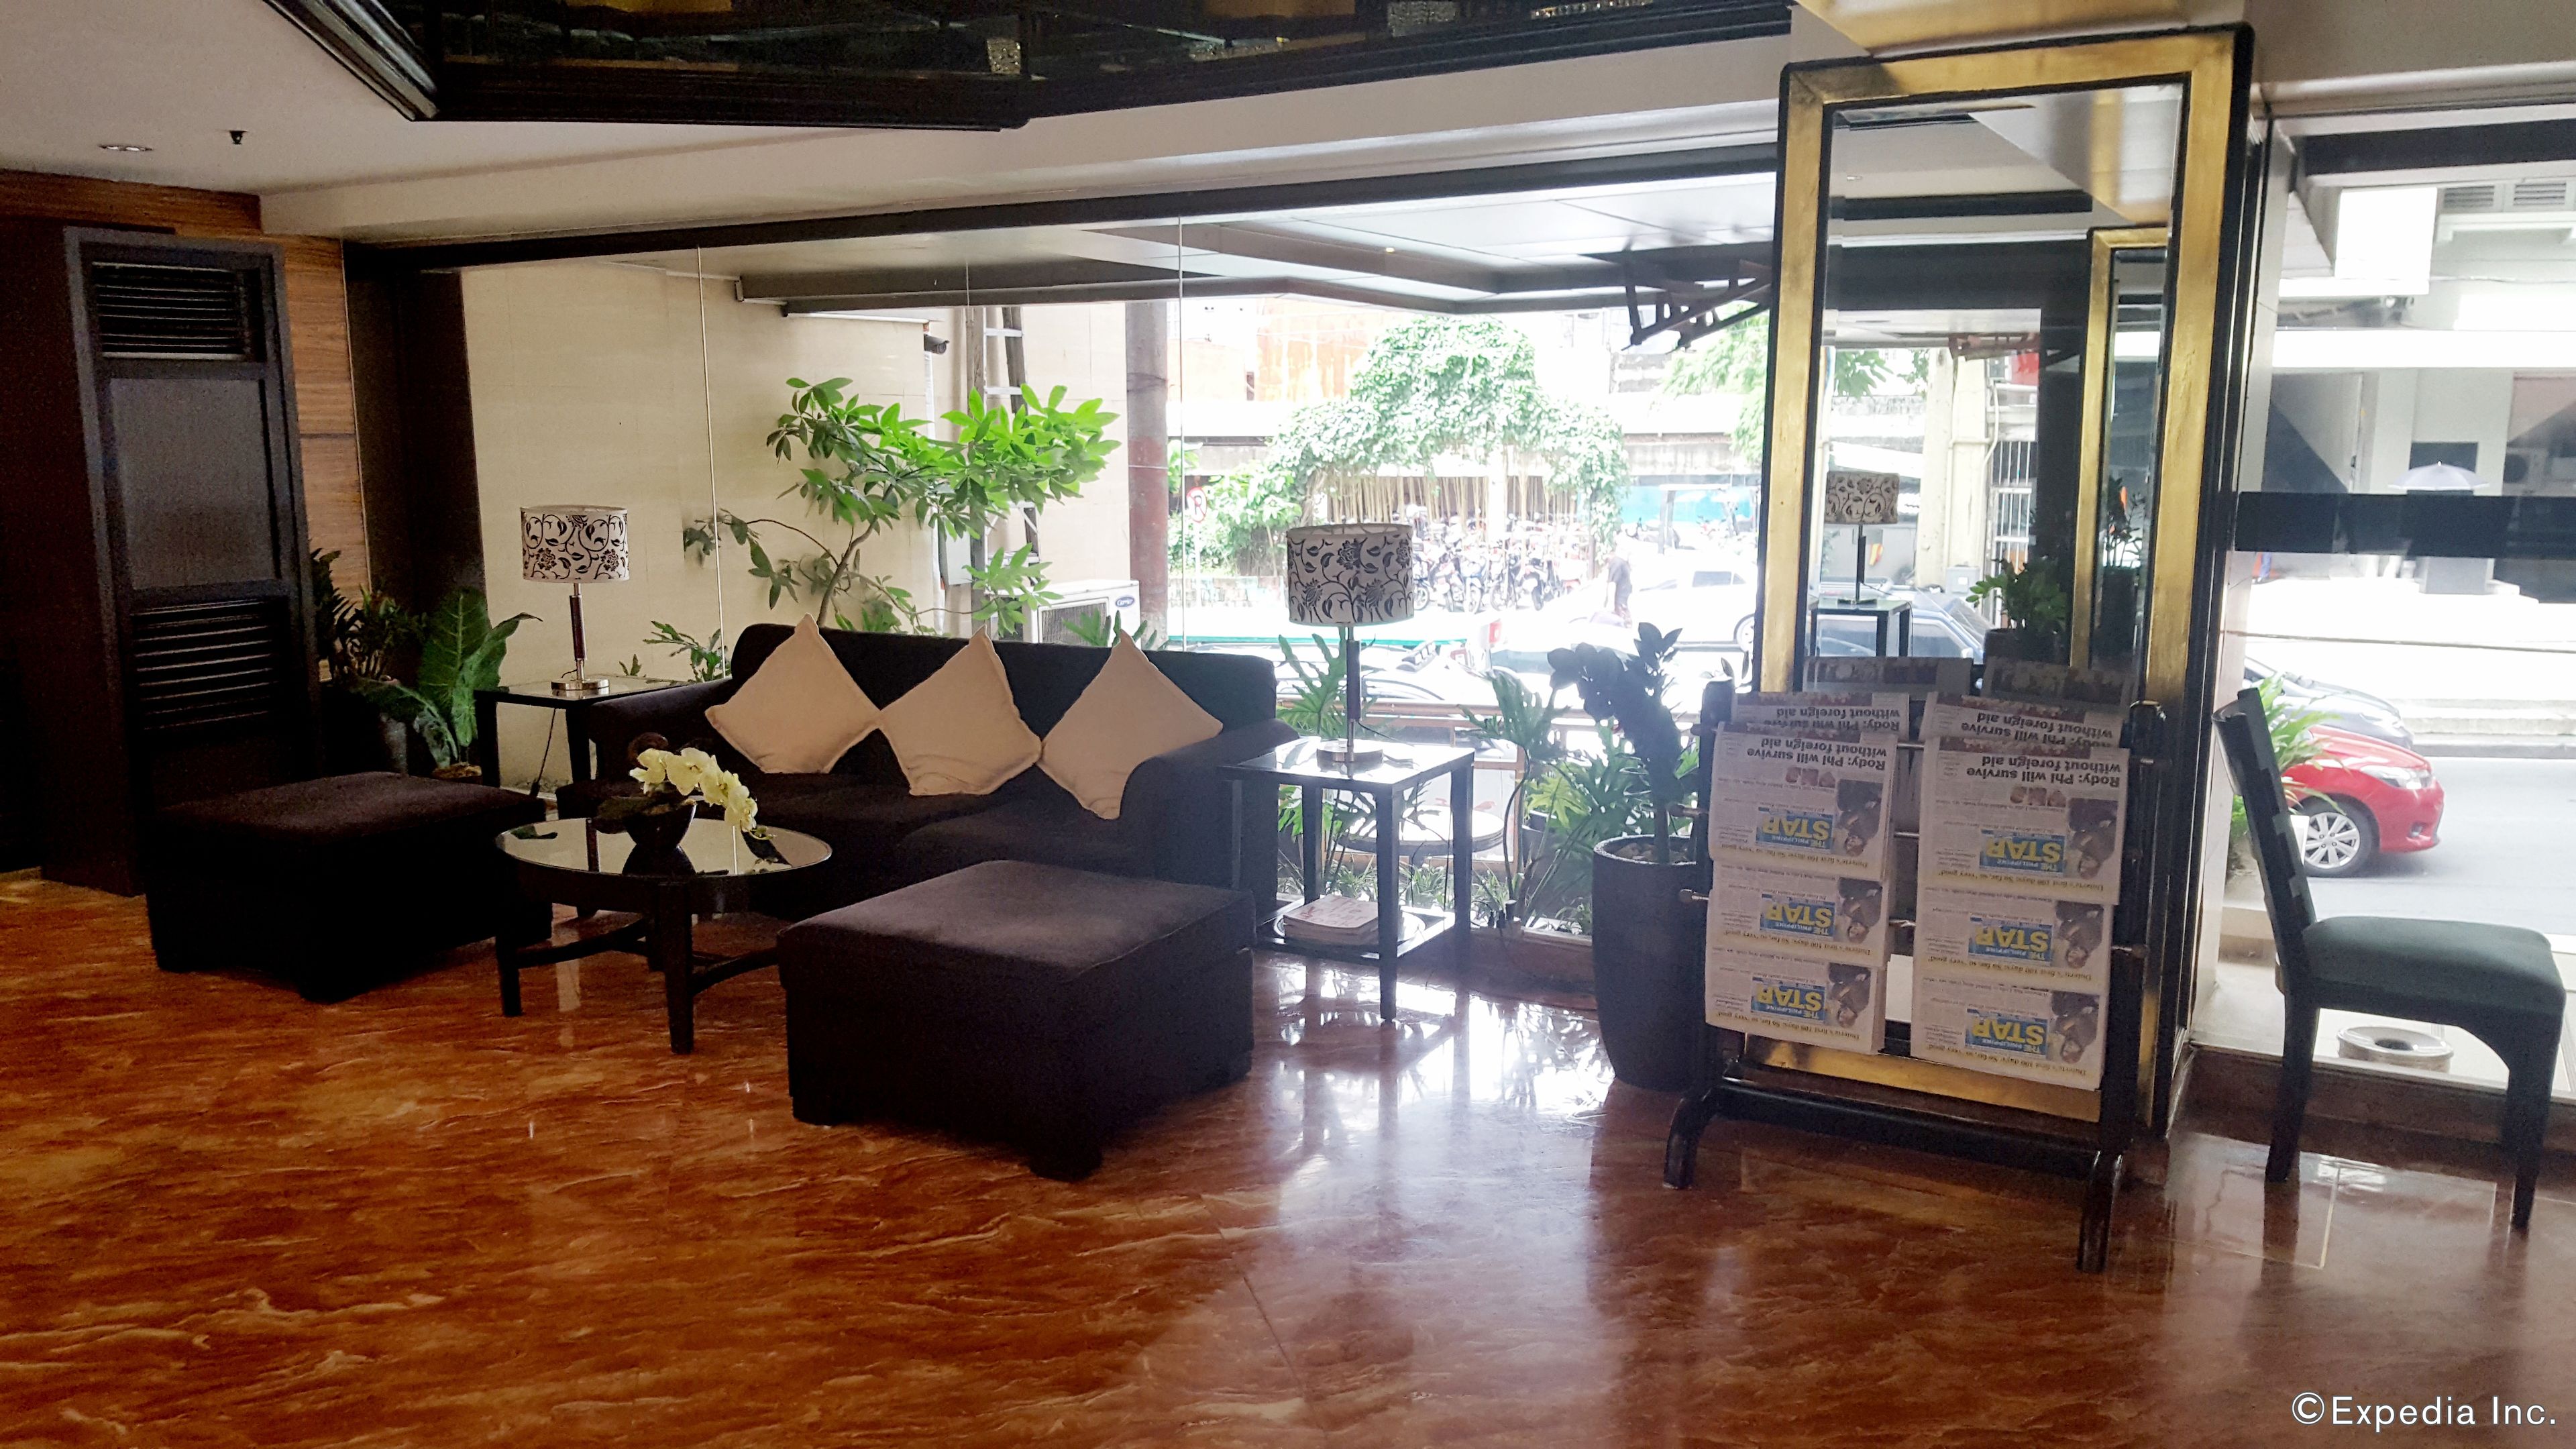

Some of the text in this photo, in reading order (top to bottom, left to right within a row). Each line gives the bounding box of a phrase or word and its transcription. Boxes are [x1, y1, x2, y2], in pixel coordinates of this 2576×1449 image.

[1776, 707, 1900, 720] without foreign aid
[1962, 723, 2011, 735] survive
[1976, 712, 2112, 739] without foreign aid
[2015, 731, 2038, 741] will
[2042, 734, 2065, 745] Phl
[1761, 739, 1886, 758] without foreign aid
[1747, 749, 1885, 771] Rody: Phl will survive
[1982, 756, 2121, 774] without foreign aid
[1966, 768, 2120, 788] Rody: Phl will survive
[1762, 816, 1830, 841] STAR
[1772, 836, 1825, 848] THE PHILIPPINE
[1986, 837, 2061, 863] STAR
[2041, 863, 2057, 871] THE
[1765, 902, 1832, 928] STAR
[1776, 922, 1829, 935] THE PHILIPPINE
[1975, 927, 2048, 952] STAR
[1986, 947, 2045, 961] THE PHILIPPINE
[1757, 984, 1821, 1012] STAR
[1765, 1004, 1819, 1019] THE PHILIPPINE
[1972, 1017, 2045, 1045] STAR
[2023, 1044, 2039, 1054] THE
